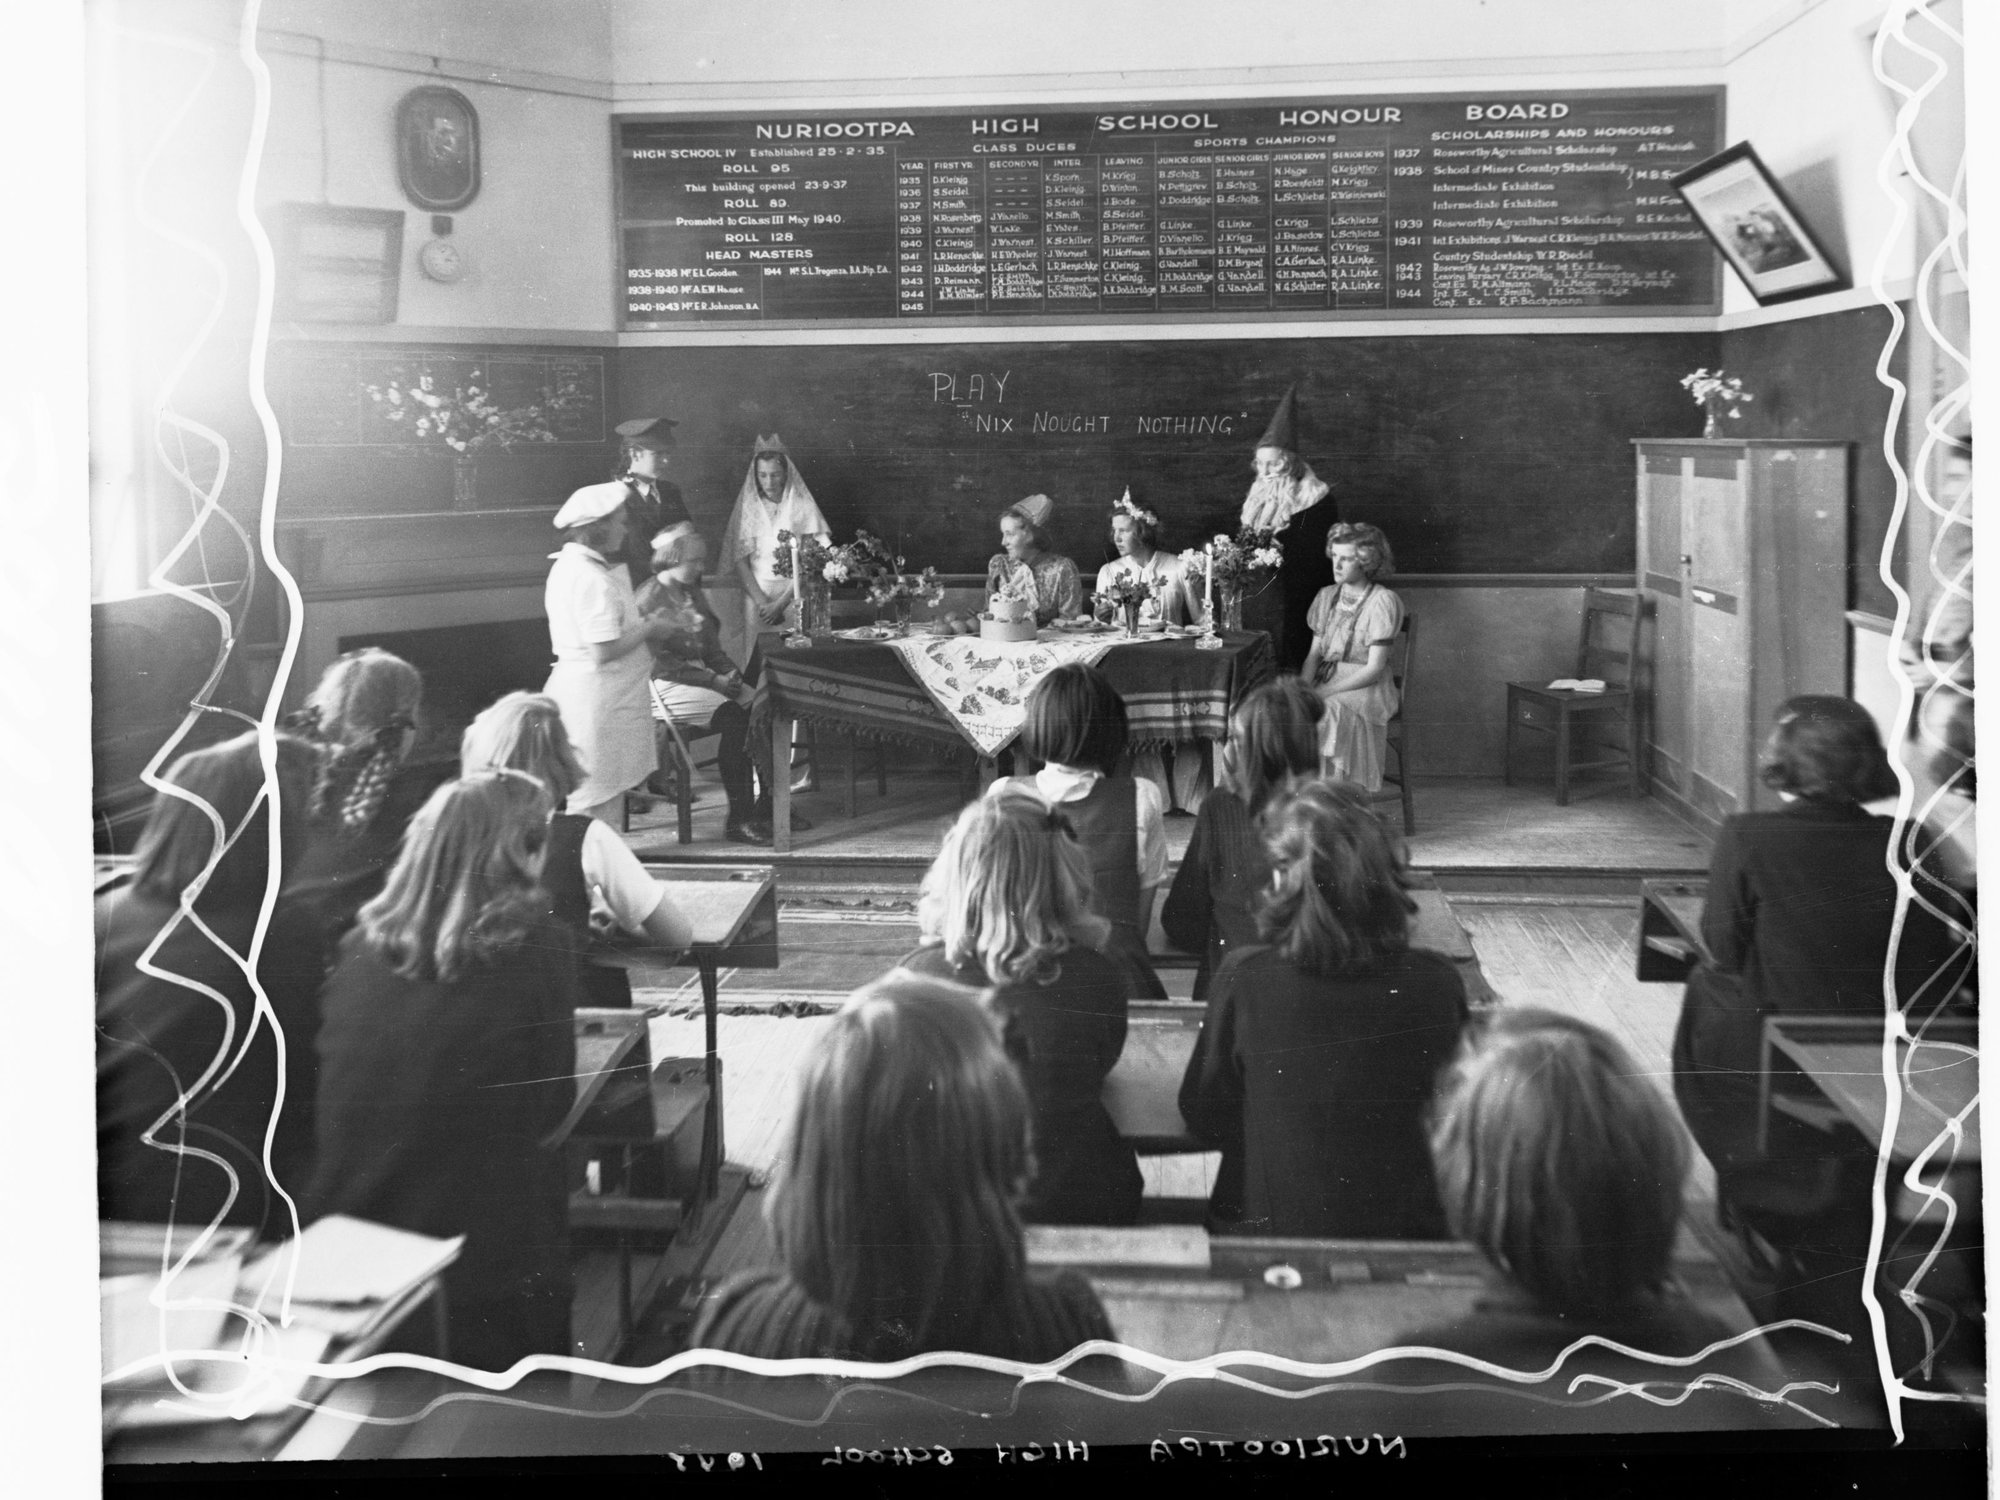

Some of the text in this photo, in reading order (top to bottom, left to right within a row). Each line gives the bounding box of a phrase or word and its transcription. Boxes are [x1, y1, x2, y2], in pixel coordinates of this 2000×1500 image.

[756, 103, 1569, 140] NURIOOTPA HIGH SCHOOL HONOUR BOARD
[1430, 125, 1676, 141] SCHOLARSHIPS AND HONOURS
[1193, 134, 1337, 148] SPORTS CHAMPIONS
[633, 149, 667, 159] HIGH
[670, 148, 722, 159] SCHOOL
[725, 148, 736, 158] IV
[750, 146, 813, 158] Established
[973, 142, 1077, 153] CLASS DUCES
[1214, 153, 1269, 163] SENIOR GIRLS
[1273, 151, 1327, 161] JUNIOR BOYS
[1332, 150, 1385, 160] SENIOR BOYS
[1394, 149, 1421, 159] 1937
[934, 161, 959, 170] FIRST
[989, 160, 1026, 169] SECOND
[1053, 158, 1081, 168] INTER
[1105, 157, 1144, 166] LEAVING
[1157, 156, 1212, 165] JUNIOR GIRLS
[723, 163, 791, 174] ROLL 95
[900, 162, 924, 171] YEAR
[1394, 166, 1423, 176] 1938
[1433, 164, 1470, 175] School
[1481, 164, 1515, 173] Mines
[1517, 162, 1561, 175] Country
[900, 176, 921, 185] 1935
[685, 183, 707, 193] This
[712, 181, 754, 194] building
[759, 181, 796, 193] opened
[1433, 181, 1499, 192] Intermediate
[900, 189, 921, 197] 1936
[724, 198, 759, 209] ROLL
[900, 201, 921, 210] 1937
[1433, 200, 1500, 210] Intermediate
[676, 216, 724, 227] Promoted
[727, 216, 737, 226] to
[738, 215, 771, 226] Class
[771, 215, 785, 225] III
[788, 214, 810, 227] May
[900, 214, 922, 223] 1938
[1394, 218, 1423, 229] 1939
[1433, 217, 1494, 230] Roseworthy
[900, 226, 922, 235] 1939
[725, 233, 760, 243] ROLL
[1394, 236, 1421, 247] 1941
[900, 239, 923, 248] 1940
[706, 249, 814, 260] HEAD MASTERS
[900, 252, 920, 261] 1941
[1433, 250, 1534, 264] Country Studentship
[628, 268, 678, 278] 1935-1938
[764, 267, 782, 276] 1944
[900, 265, 923, 273] 1942
[1395, 263, 1423, 273] 1942
[900, 277, 924, 286] 1943
[1395, 272, 1422, 281] 1943
[628, 285, 679, 295] 1938-1940
[901, 290, 924, 299] 1944
[1396, 288, 1422, 298] 1944
[629, 302, 680, 312] 1940-1943
[901, 302, 924, 311] 1945
[928, 370, 1010, 403] PLAY
[1033, 411, 1110, 434] NOUGHT
